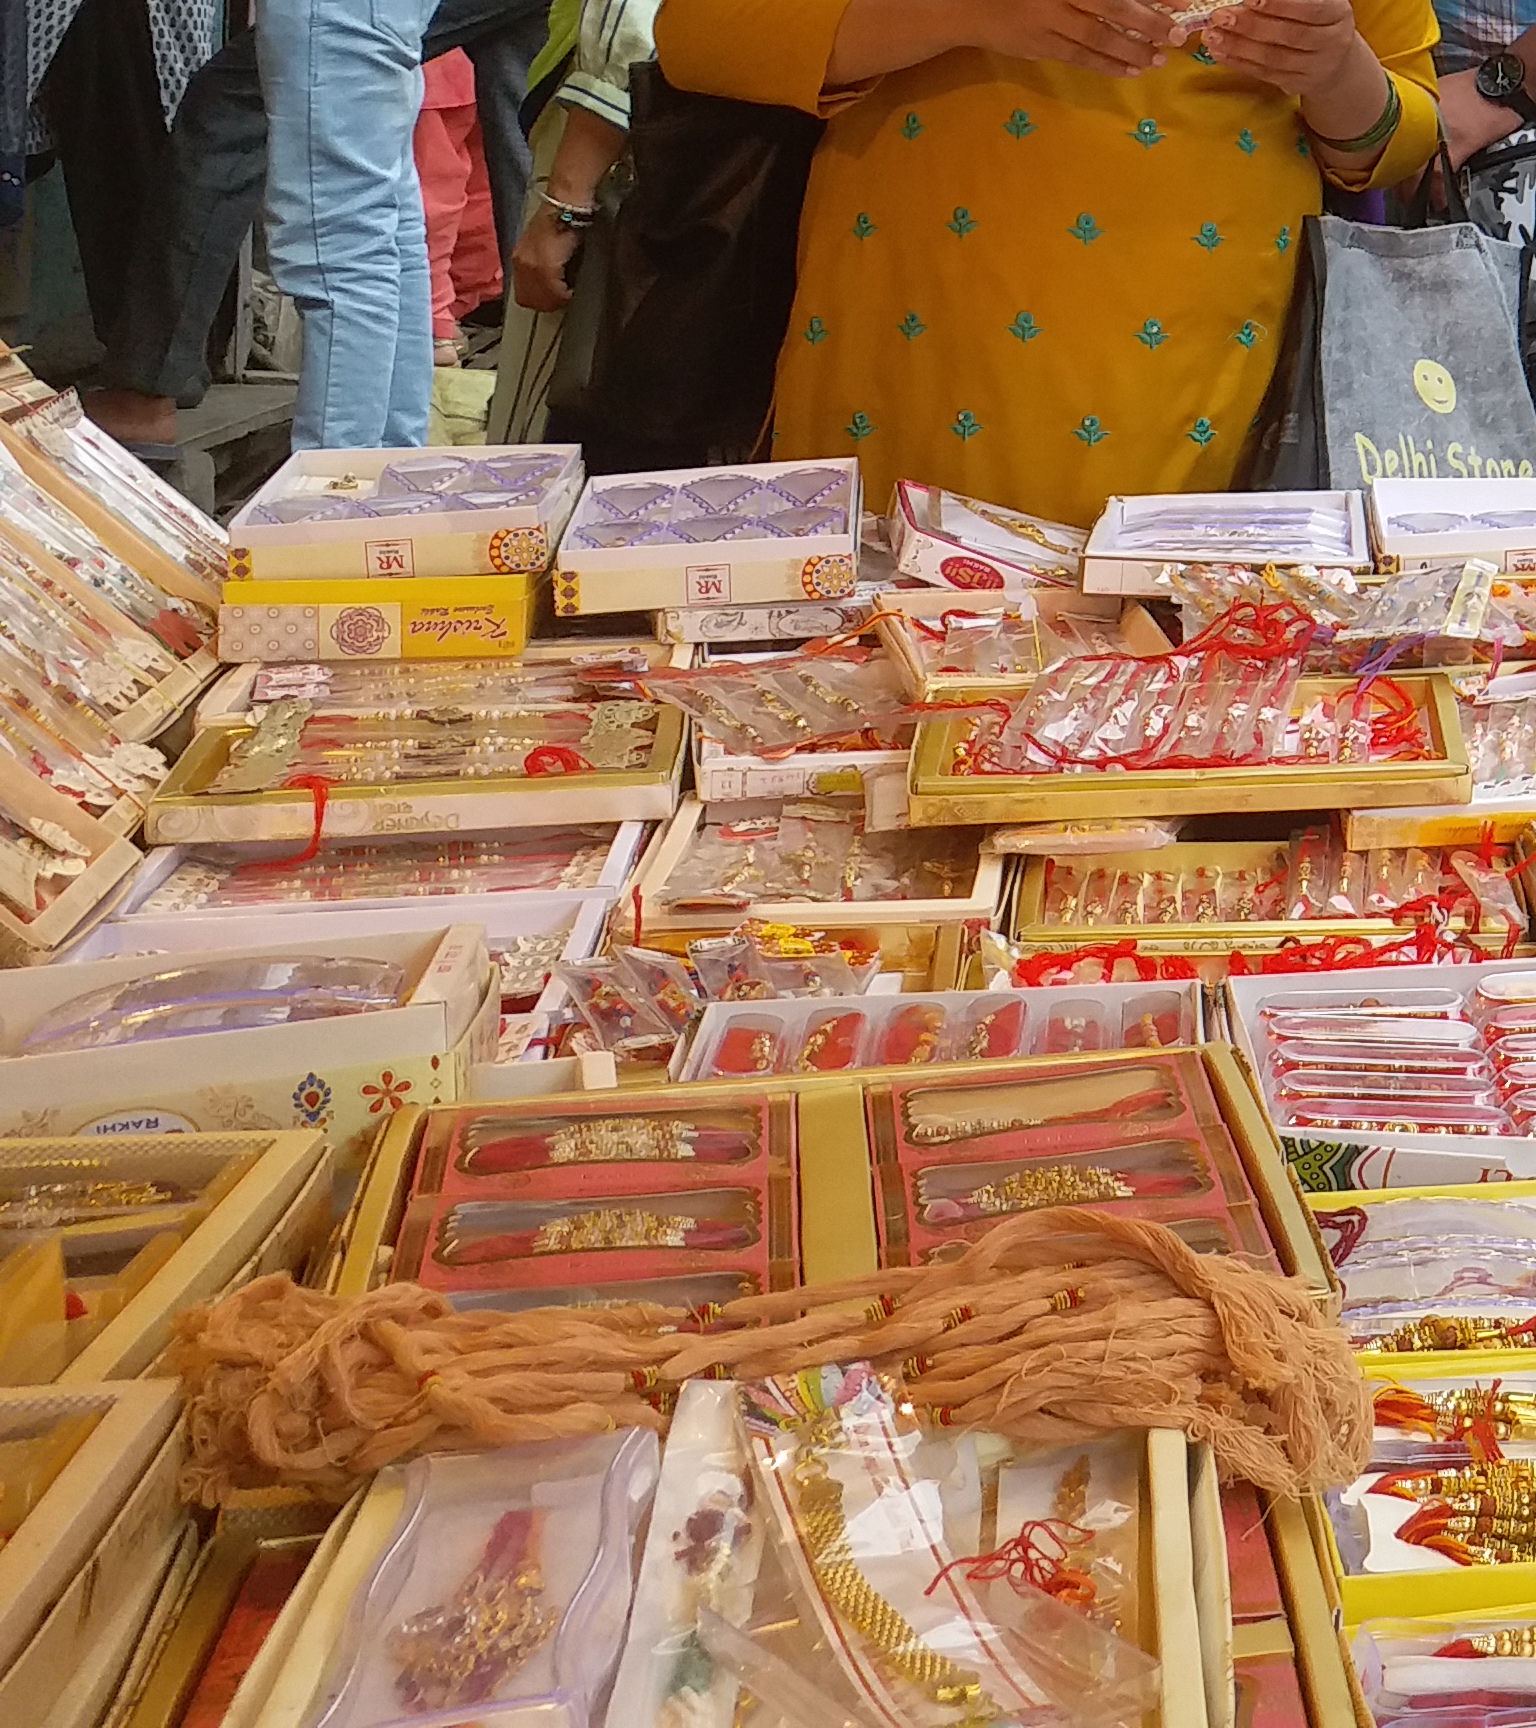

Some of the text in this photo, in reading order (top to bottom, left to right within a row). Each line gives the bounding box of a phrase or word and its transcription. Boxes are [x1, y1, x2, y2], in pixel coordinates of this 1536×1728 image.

[1354, 431, 1437, 485] Delhi
[376, 554, 405, 571] MR
[695, 579, 723, 595] MR
[409, 617, 508, 643] Krishna
[95, 1116, 160, 1135] RAKHI
